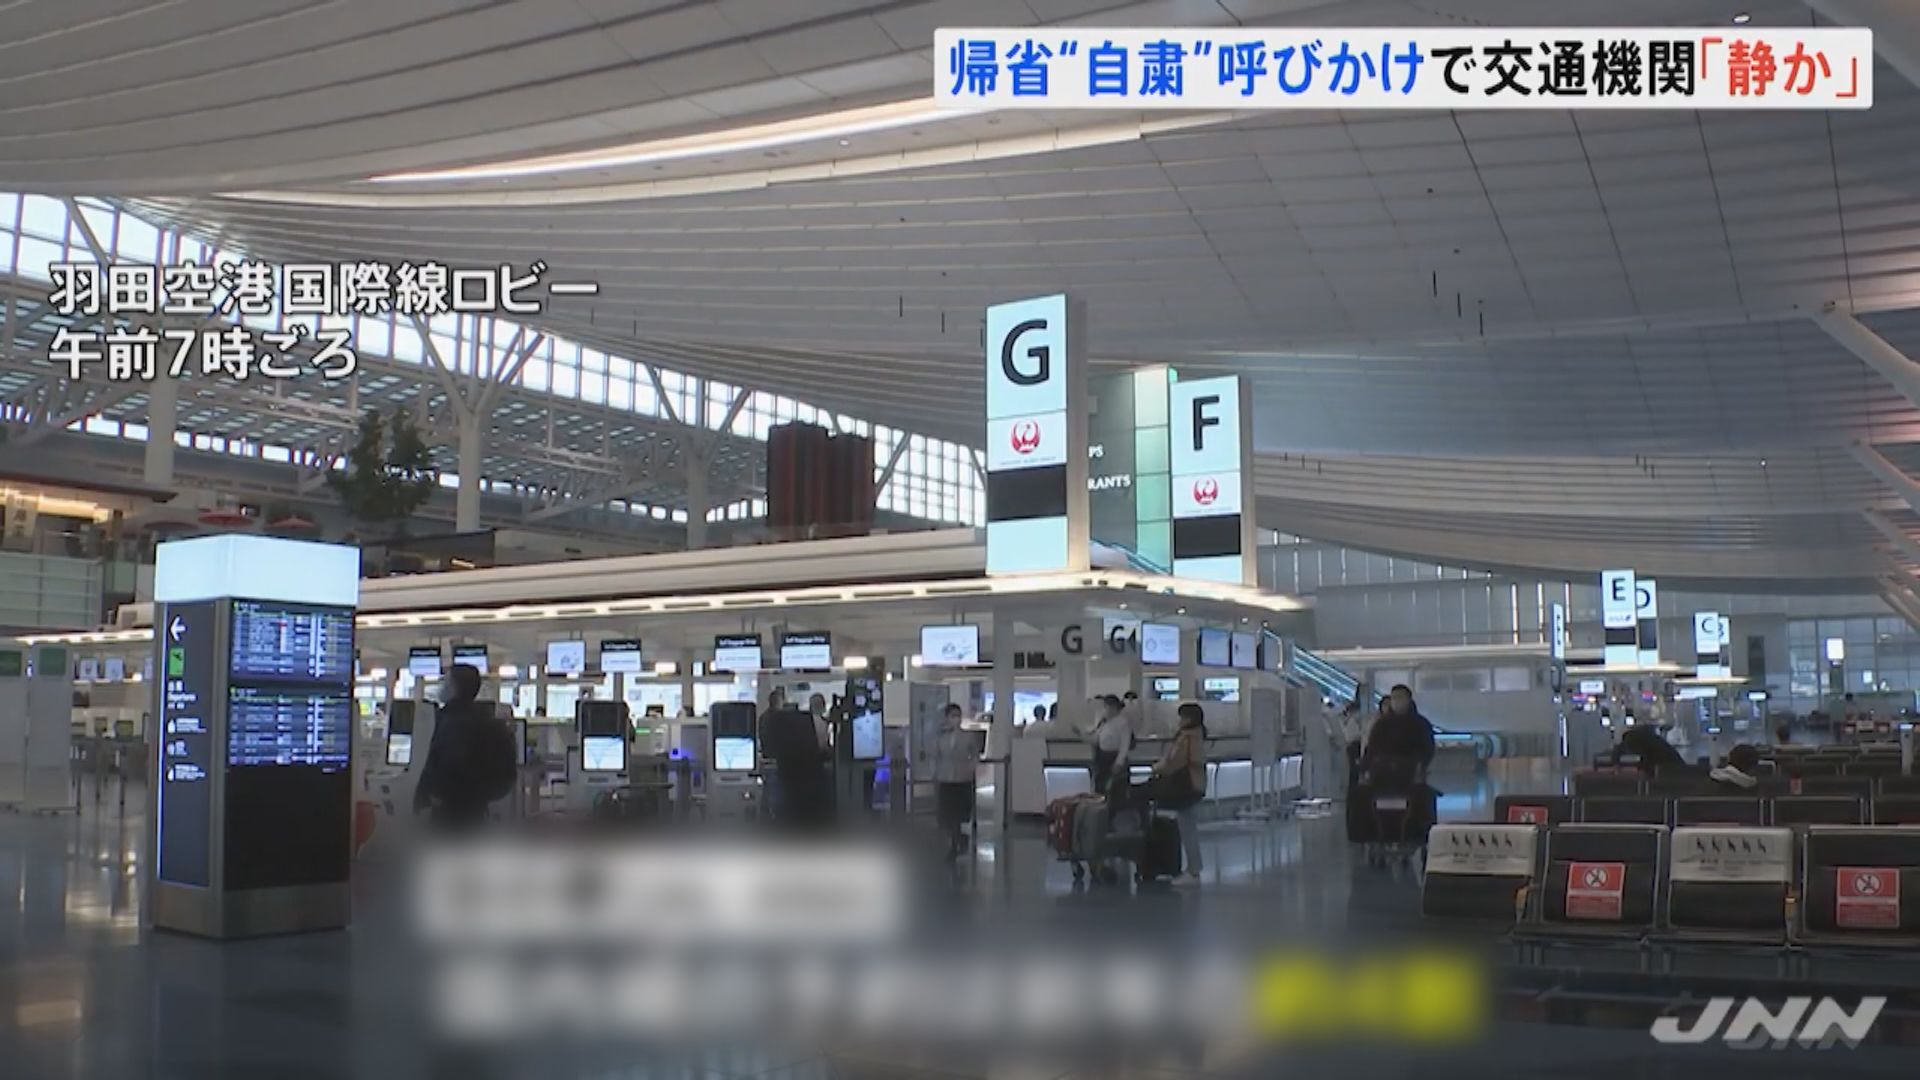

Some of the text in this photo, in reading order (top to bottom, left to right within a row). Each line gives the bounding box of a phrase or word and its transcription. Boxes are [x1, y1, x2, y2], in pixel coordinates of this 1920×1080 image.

[1001, 318, 1050, 387] G
[1192, 394, 1220, 452] F
[1612, 578, 1626, 601] E
[1061, 625, 1083, 654] G
[1701, 617, 1714, 634] C
